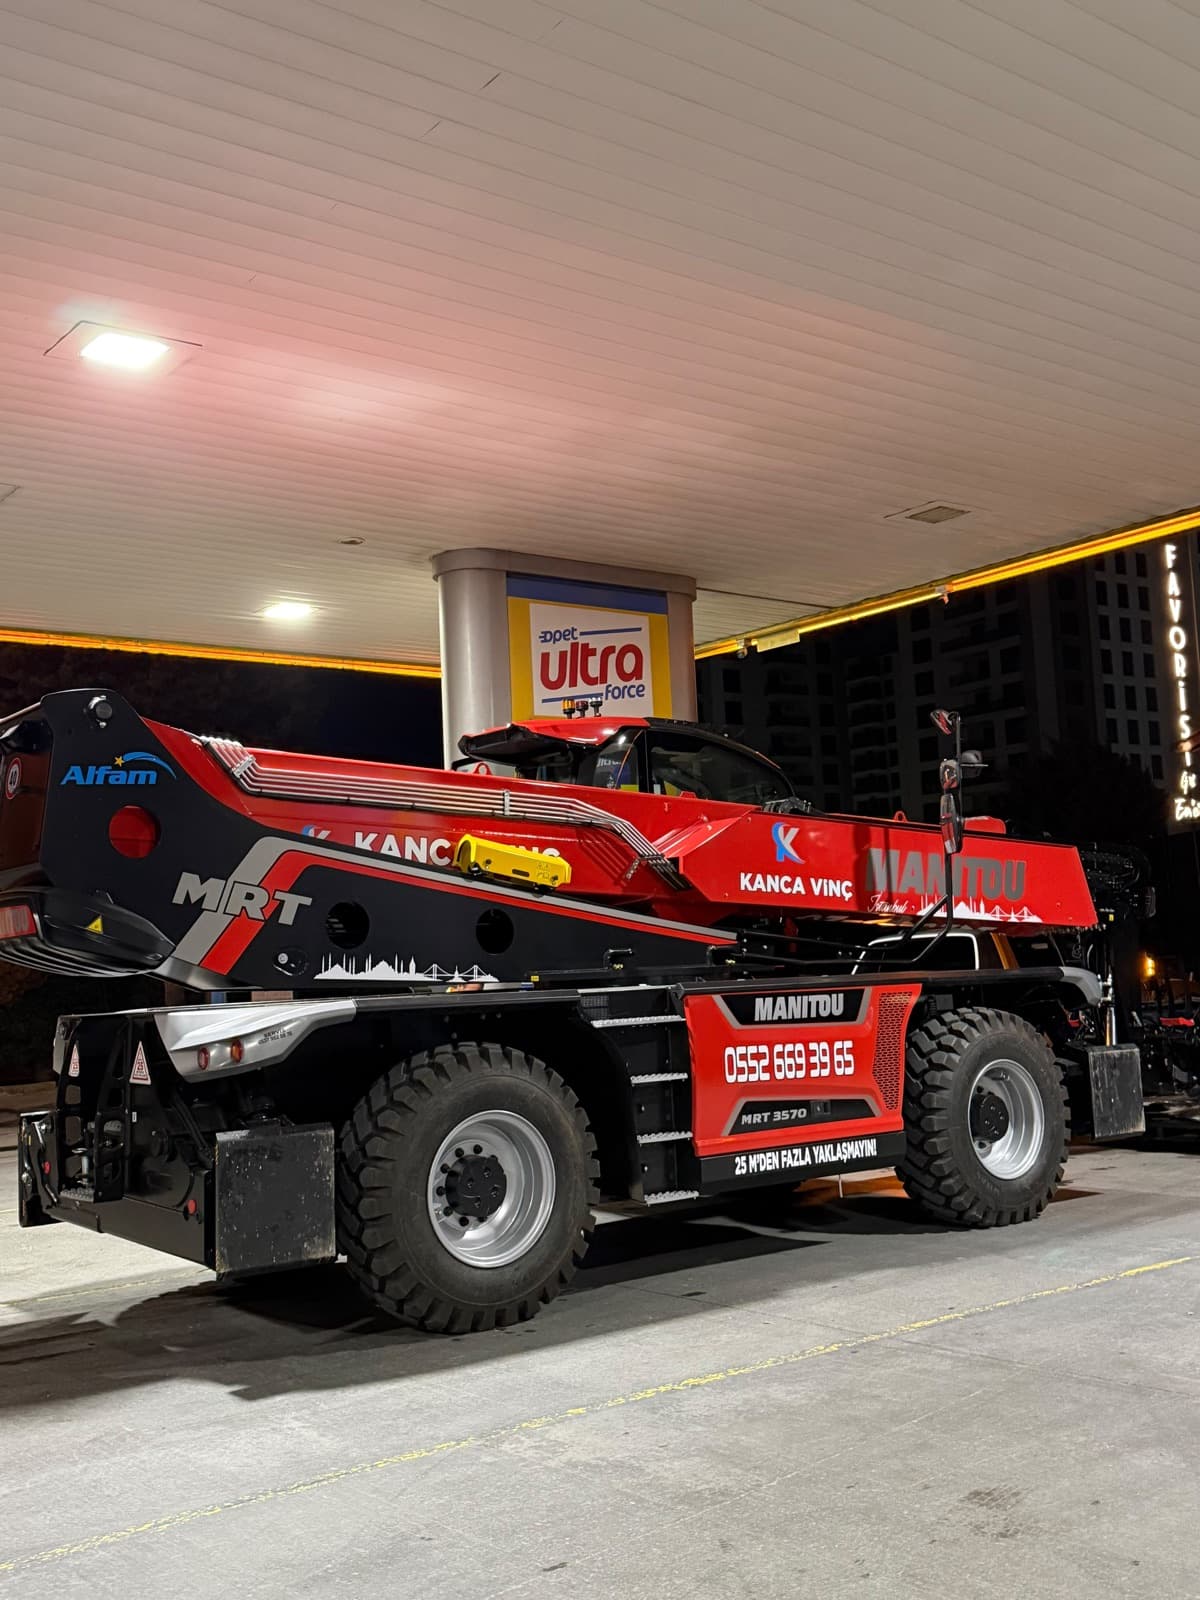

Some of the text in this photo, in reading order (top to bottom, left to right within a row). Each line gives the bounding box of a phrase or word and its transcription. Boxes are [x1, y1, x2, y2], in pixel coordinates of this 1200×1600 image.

[540, 641, 644, 691] ultra
[604, 683, 646, 701] force
[60, 764, 157, 786] Alfam
[355, 831, 452, 867] KANC
[740, 872, 853, 902] KANCA VİNÇ
[865, 847, 1027, 903] MANITOU
[172, 871, 313, 926] MRT
[754, 992, 845, 1022] MANITOU
[724, 1039, 855, 1084] 0552 669 39 65
[741, 1107, 807, 1125] MRT 3570
[735, 1137, 877, 1176] 25 M'DEN FAZLA YAKLAŞMAYIN!
